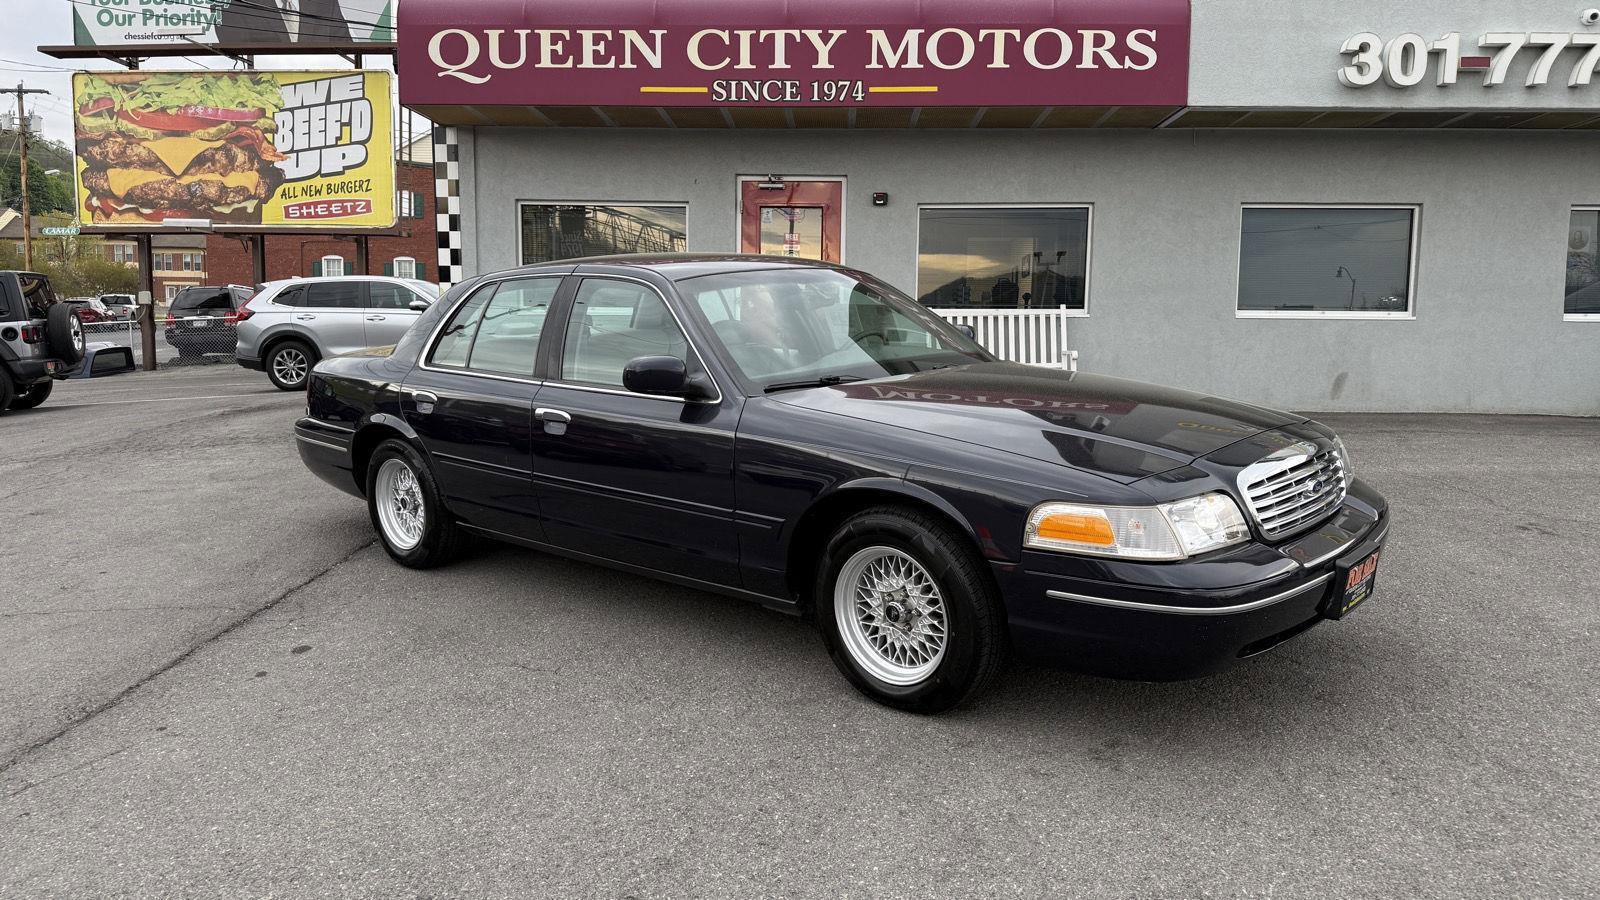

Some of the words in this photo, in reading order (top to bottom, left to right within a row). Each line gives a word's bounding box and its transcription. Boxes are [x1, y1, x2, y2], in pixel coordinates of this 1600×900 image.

[96, 8, 136, 27] Our
[141, 7, 223, 32] Priority!
[427, 28, 668, 85] QUEEN
[686, 28, 848, 71] CITY
[864, 27, 1159, 71] MOTORS
[280, 73, 364, 109] WE
[711, 79, 802, 102] SINCE
[809, 79, 866, 102] 1974
[273, 99, 373, 153] BEEF'D
[275, 144, 368, 180] UP
[280, 187, 299, 200] ALL
[301, 183, 324, 198] NEW
[326, 178, 373, 196] BURGERZ
[288, 200, 367, 218] SHEETZ
[45, 227, 78, 235] LAMAR
